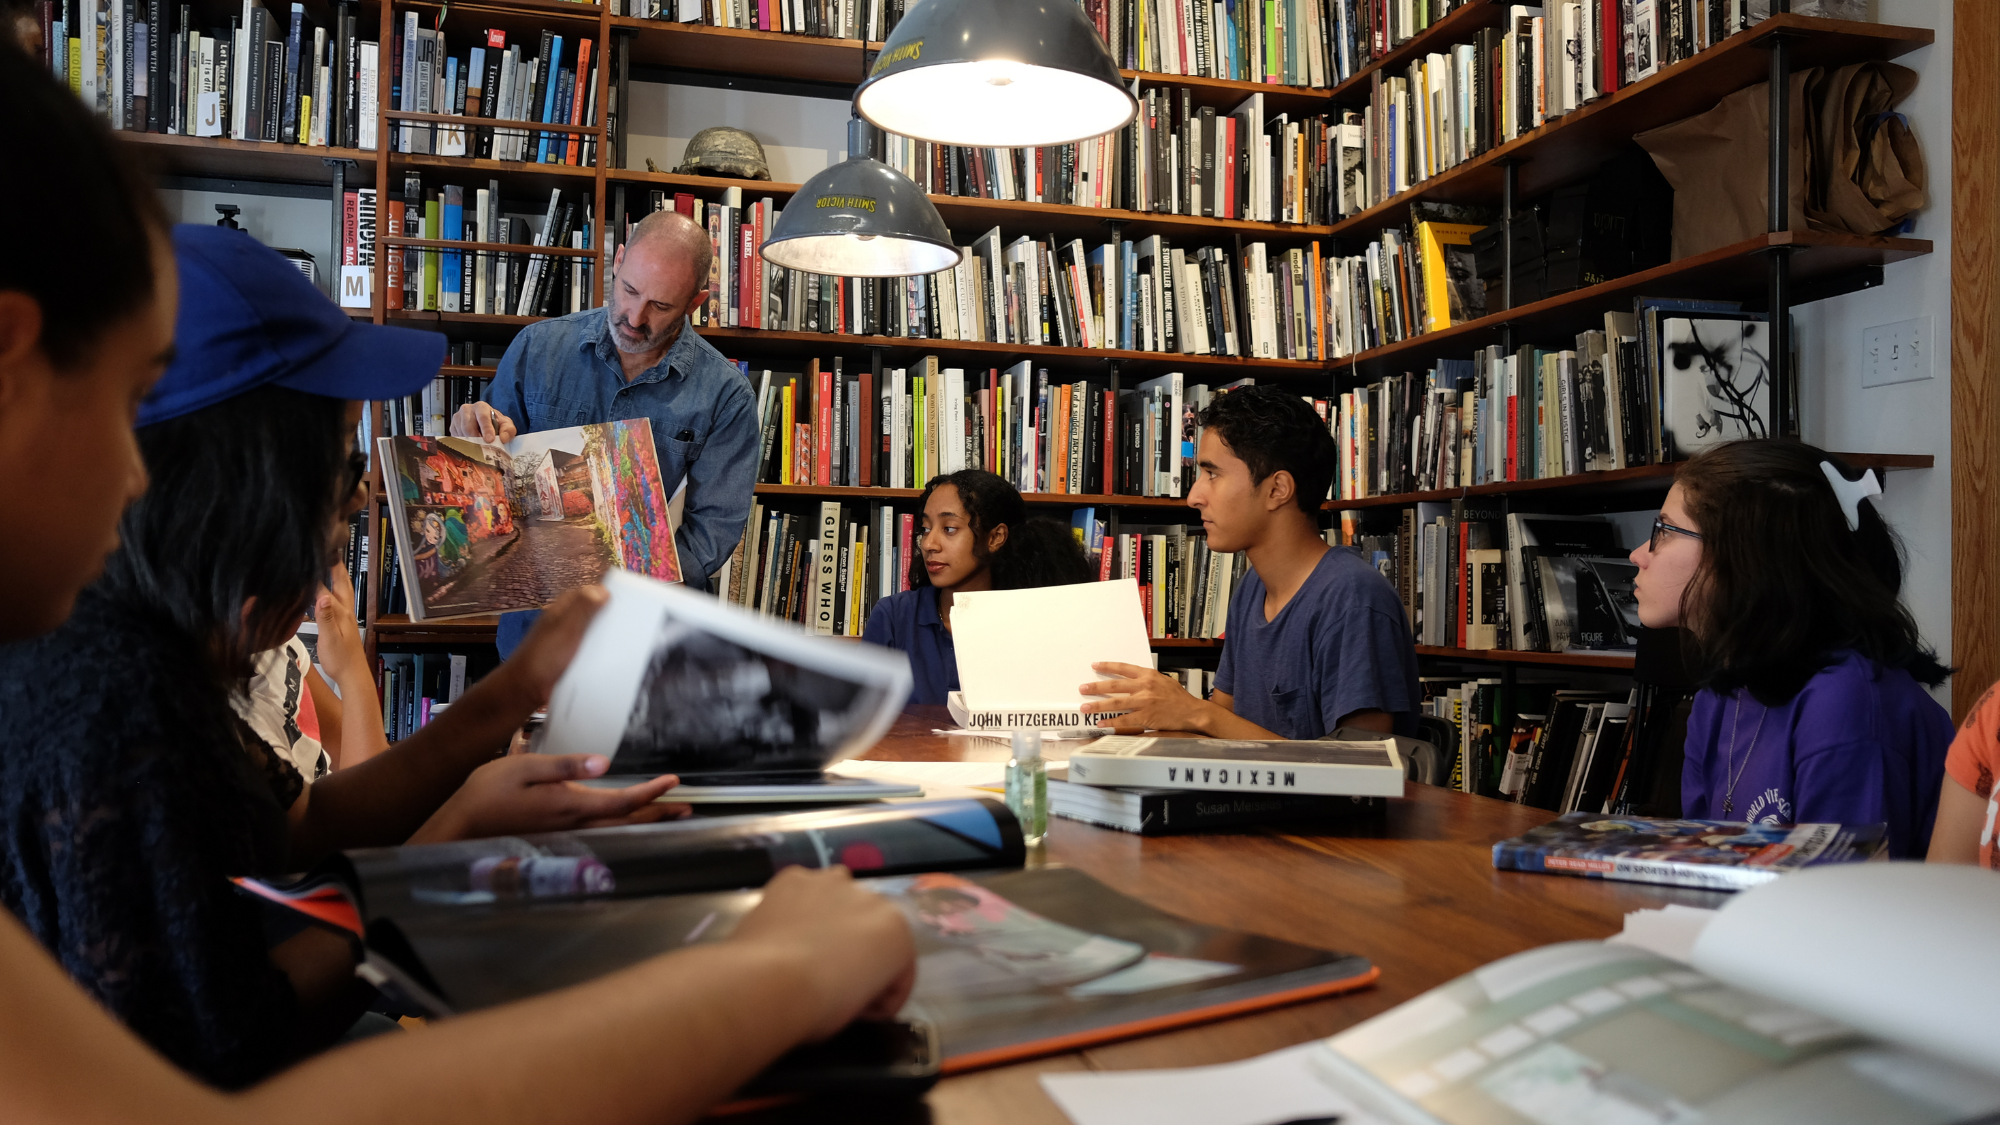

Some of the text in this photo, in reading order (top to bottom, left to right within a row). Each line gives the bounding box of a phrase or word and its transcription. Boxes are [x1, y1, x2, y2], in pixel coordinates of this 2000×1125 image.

[151, 23, 157, 32] TO
[407, 17, 415, 39] WOMEN
[406, 52, 414, 73] HEROES
[418, 39, 435, 64] JR
[540, 37, 551, 84] YOUSUF KARSH
[219, 60, 227, 82] There
[219, 84, 226, 94] Be
[420, 63, 429, 107] CAN ART CHANGE THE
[485, 64, 498, 116] Timeless
[370, 92, 376, 102] OF
[205, 104, 215, 126] J
[447, 124, 462, 145] K
[816, 196, 876, 213] SMITH VICTOR
[346, 200, 354, 244] READING
[744, 230, 752, 258] BABEL
[1163, 248, 1171, 288] STORYTELLER
[346, 276, 363, 296] M
[1180, 286, 1188, 322] NOSTALGIA
[1165, 312, 1173, 337] MICHALS
[1464, 509, 1501, 519] BEYOND
[385, 545, 393, 556] HIP
[1105, 547, 1113, 566] WHO
[785, 551, 793, 575] SIMPSON
[820, 516, 835, 622] GUESS WHO
[1581, 633, 1604, 642] FIGURE
[969, 713, 1002, 727] JOHN
[1008, 713, 1079, 727] FITZGERALD
[1168, 766, 1296, 788] MEXICANA
[1195, 798, 1283, 816] Susan Meiselas
[1746, 788, 1778, 823] WORLD VIE
[1547, 859, 1611, 871] PETER READ MILLER
[1617, 863, 1631, 873] ON
[1633, 864, 1668, 876] SPORTS
